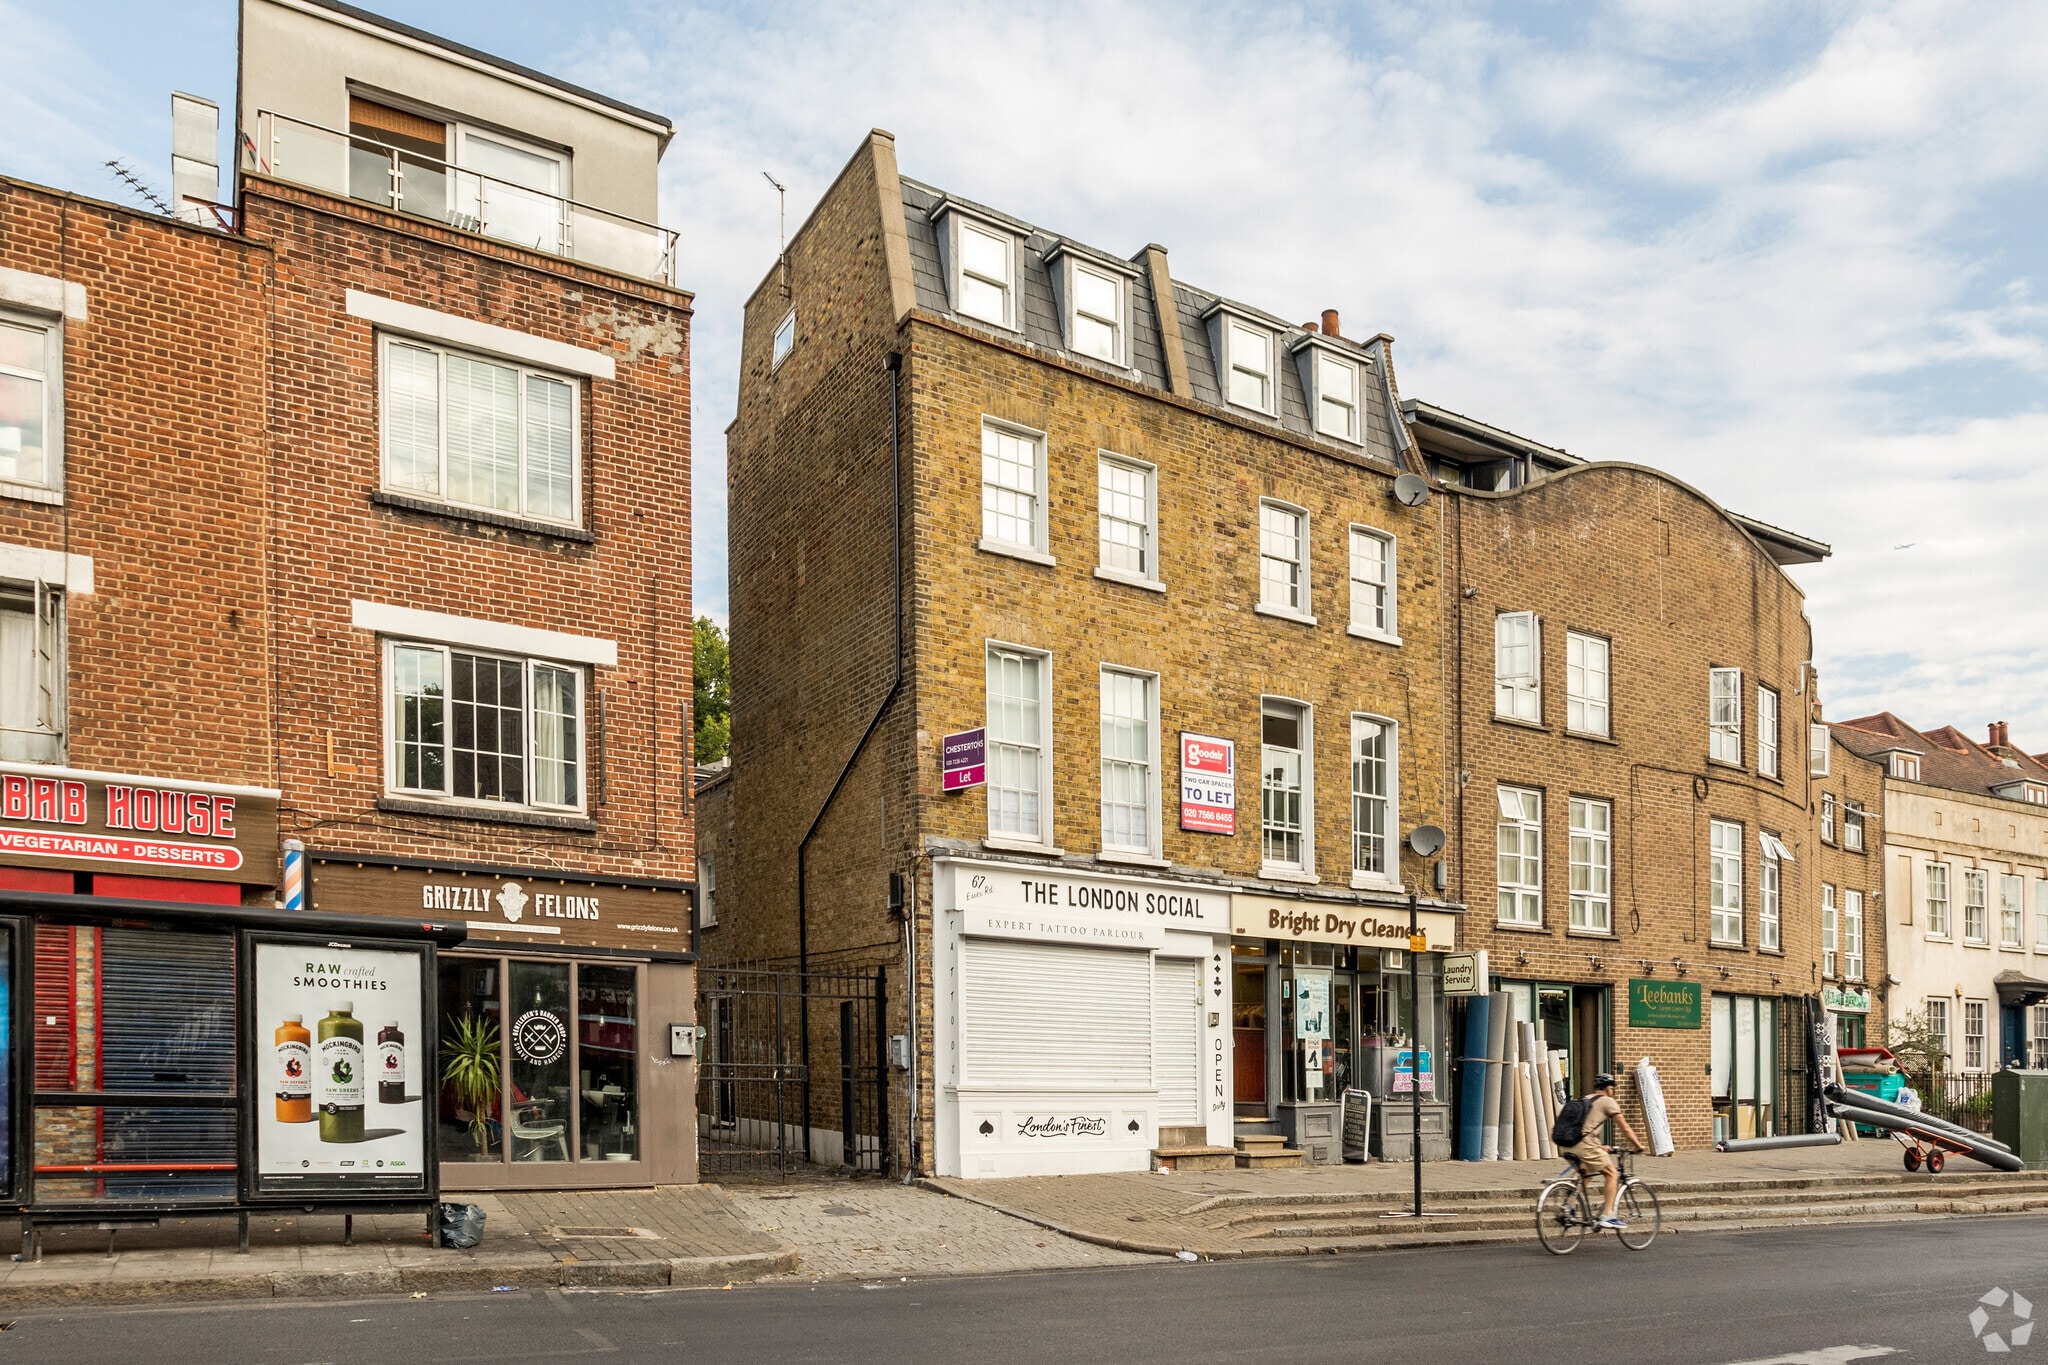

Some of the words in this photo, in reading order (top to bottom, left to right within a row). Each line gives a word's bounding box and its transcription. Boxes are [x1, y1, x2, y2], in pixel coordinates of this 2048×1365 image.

[945, 739, 984, 755] CHESTERTONS
[1188, 743, 1224, 766] goodsir
[959, 771, 972, 783] Let
[1184, 776, 1197, 784] TWO
[1198, 778, 1210, 786] CAR
[1211, 780, 1232, 789] SPACES
[1184, 787, 1202, 801] TO
[1207, 790, 1232, 805] LET
[0, 774, 88, 825] BAB
[105, 784, 236, 839] HOUSE
[1184, 808, 1197, 818] 020
[1198, 810, 1215, 820] 7566
[1215, 812, 1233, 823] 6455
[0, 833, 118, 855] VEGETARIAN
[134, 845, 226, 864] DESSERTS
[971, 875, 986, 889] 67
[423, 885, 491, 912] GRIZZLY
[535, 893, 599, 920] FELONS
[1021, 880, 1058, 906] THE
[1068, 885, 1139, 913] LONDON
[1146, 893, 1204, 919] SOCIAL
[616, 923, 680, 934] www.grizzlyfelons.co.uk
[988, 919, 1033, 931] EXPERT
[1040, 923, 1087, 936] TATTOO
[1093, 927, 1145, 941] PARLOUR
[1269, 908, 1320, 936] Bright
[1325, 913, 1356, 939] Dry
[305, 962, 341, 975] RAW
[343, 966, 376, 979] crafted
[1443, 964, 1472, 975] Laundry
[293, 976, 387, 991] SMOOTHIES
[1445, 974, 1470, 984] Service
[1637, 985, 1693, 1010] Leebanks
[321, 1041, 361, 1054] MOCKINGBIRD
[529, 1058, 542, 1066] AND
[1393, 1081, 1434, 1091] ALTERONS
[1017, 1116, 1069, 1137] London's
[1069, 1116, 1106, 1134] Finest
